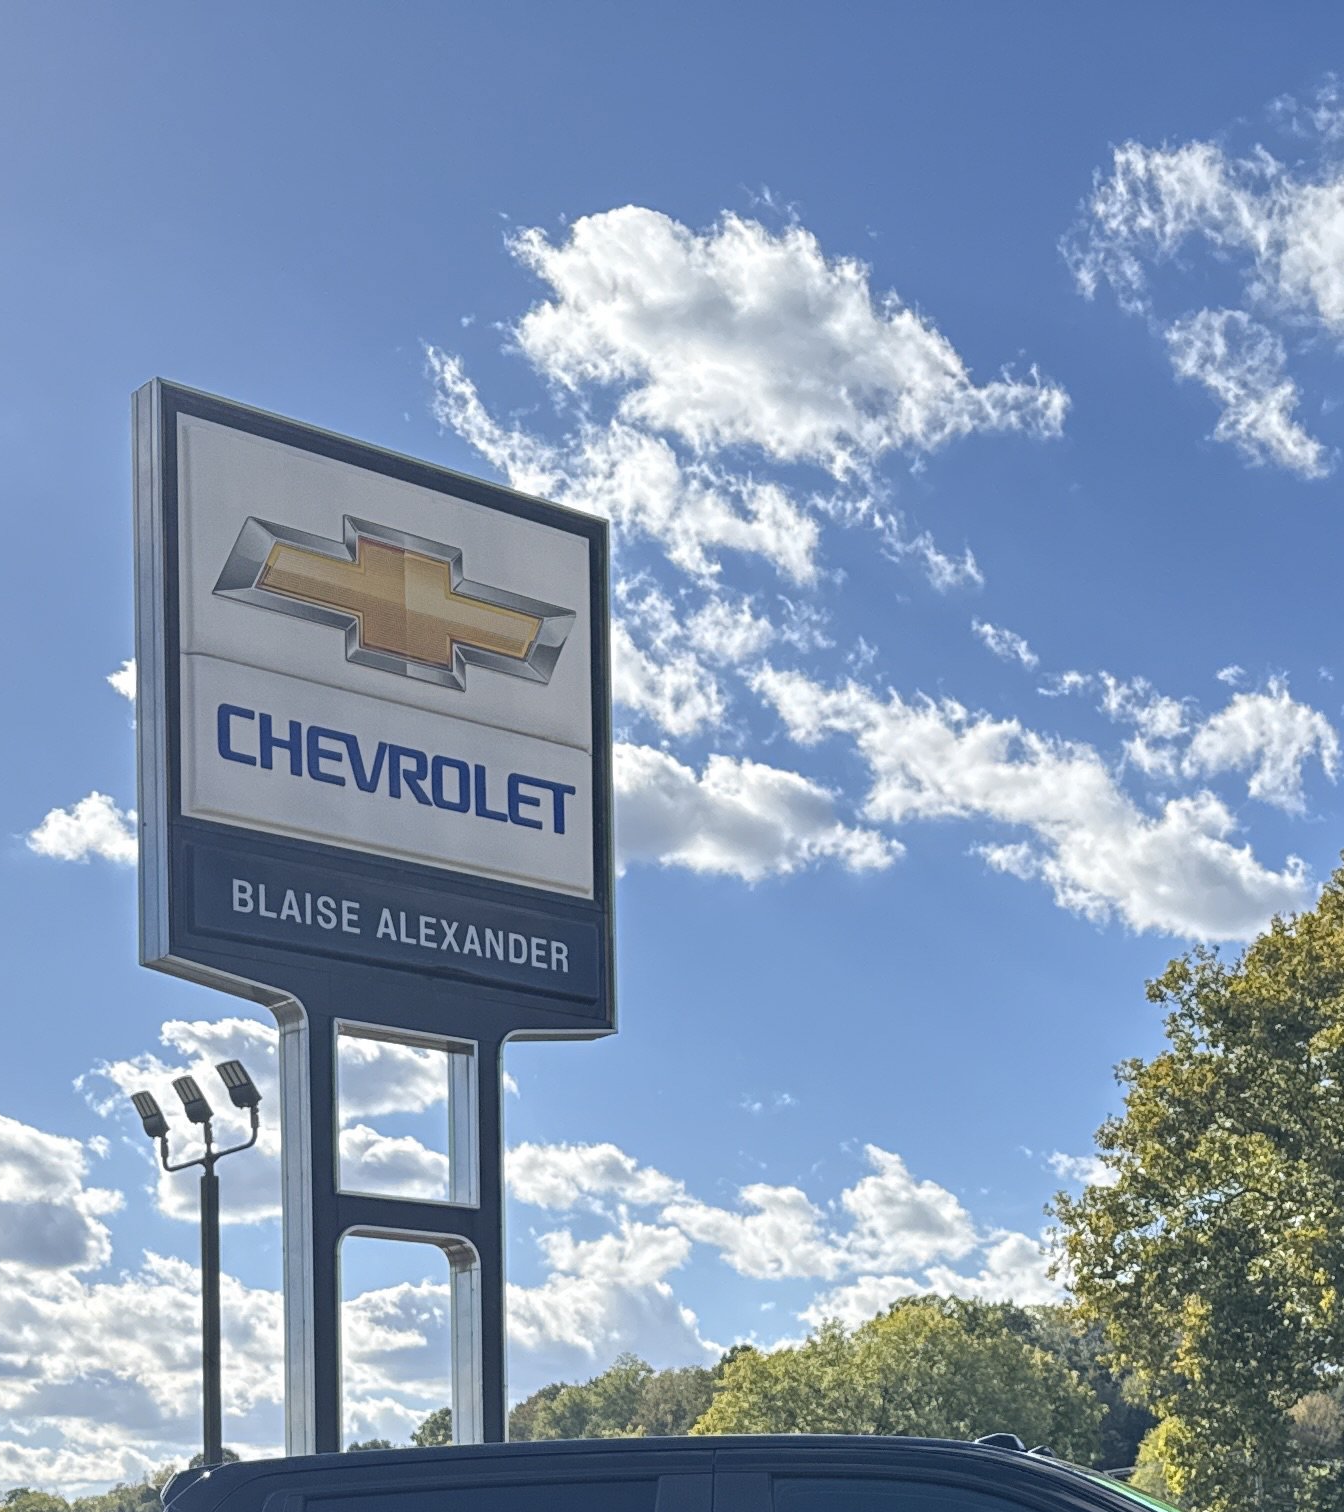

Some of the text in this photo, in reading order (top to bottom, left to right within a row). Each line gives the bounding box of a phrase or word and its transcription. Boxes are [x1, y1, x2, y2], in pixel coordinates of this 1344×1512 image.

[216, 702, 576, 835] CHEVROLET
[231, 877, 571, 974] BLAISE ALEXANDER
